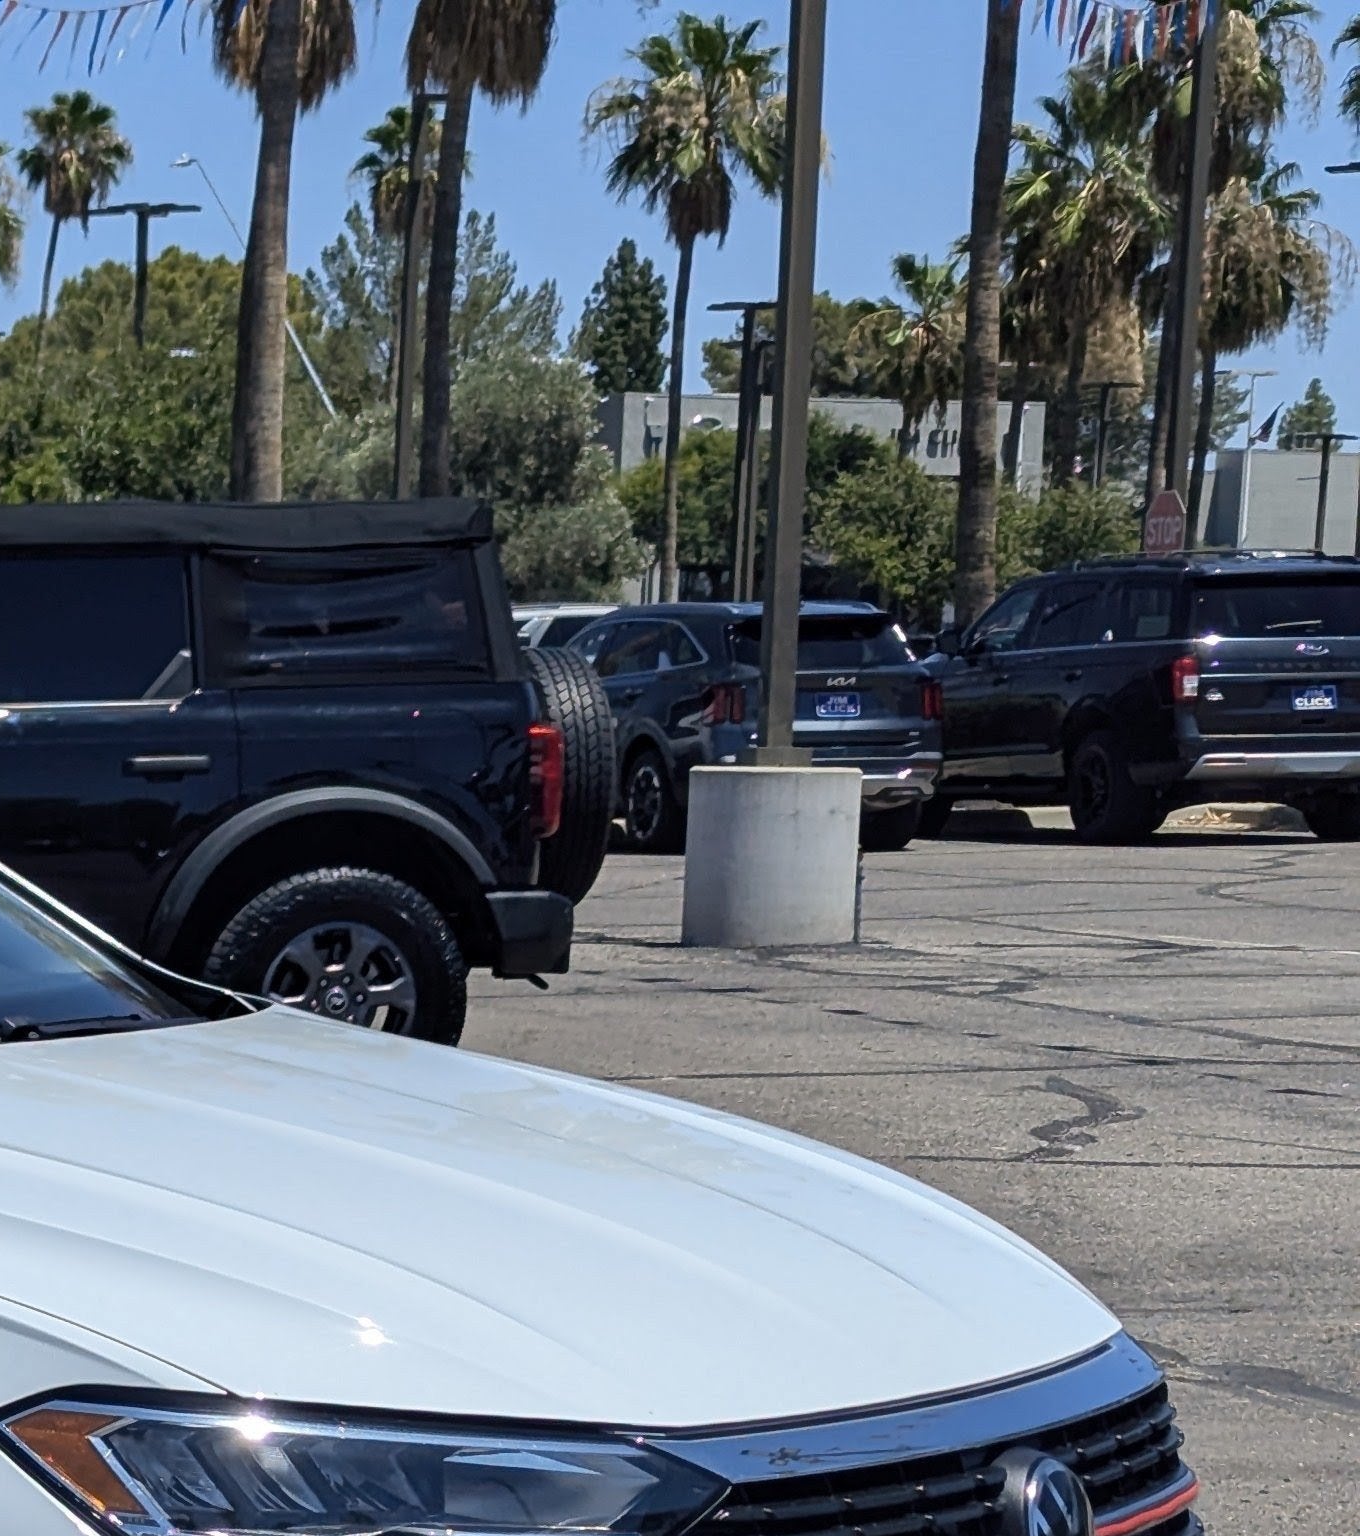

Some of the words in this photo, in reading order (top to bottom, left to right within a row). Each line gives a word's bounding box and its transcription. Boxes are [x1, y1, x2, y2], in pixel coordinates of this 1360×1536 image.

[1147, 515, 1182, 545] STOP
[1294, 697, 1333, 707] CLICK
[819, 703, 857, 714] CLICK
